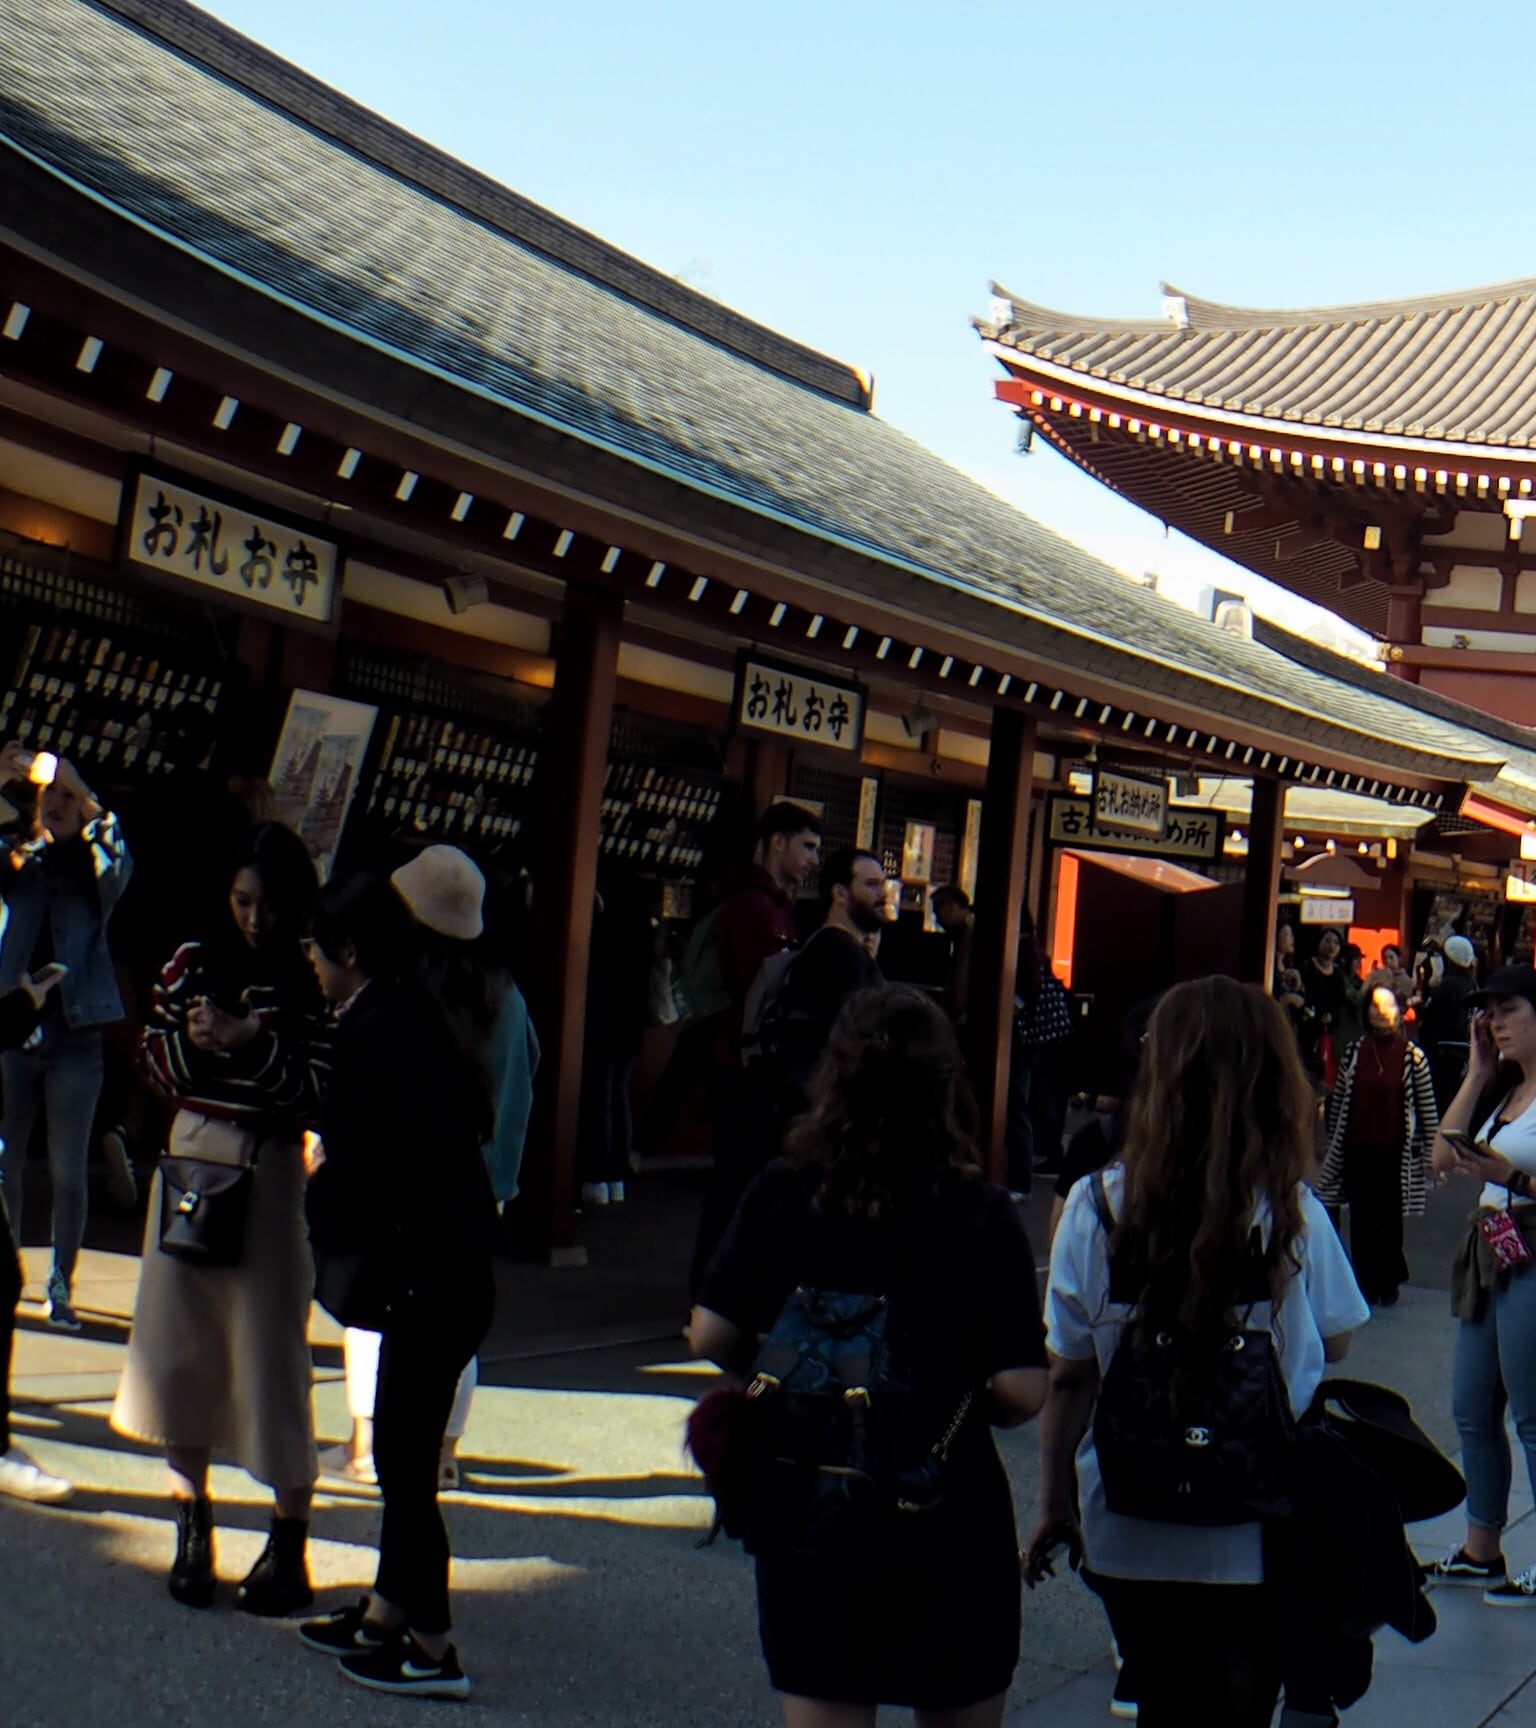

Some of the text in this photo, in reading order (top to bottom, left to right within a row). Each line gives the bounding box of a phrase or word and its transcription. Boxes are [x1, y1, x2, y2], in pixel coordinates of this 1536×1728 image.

[144, 490, 319, 607] お札お守
[748, 672, 849, 741] お札お守
